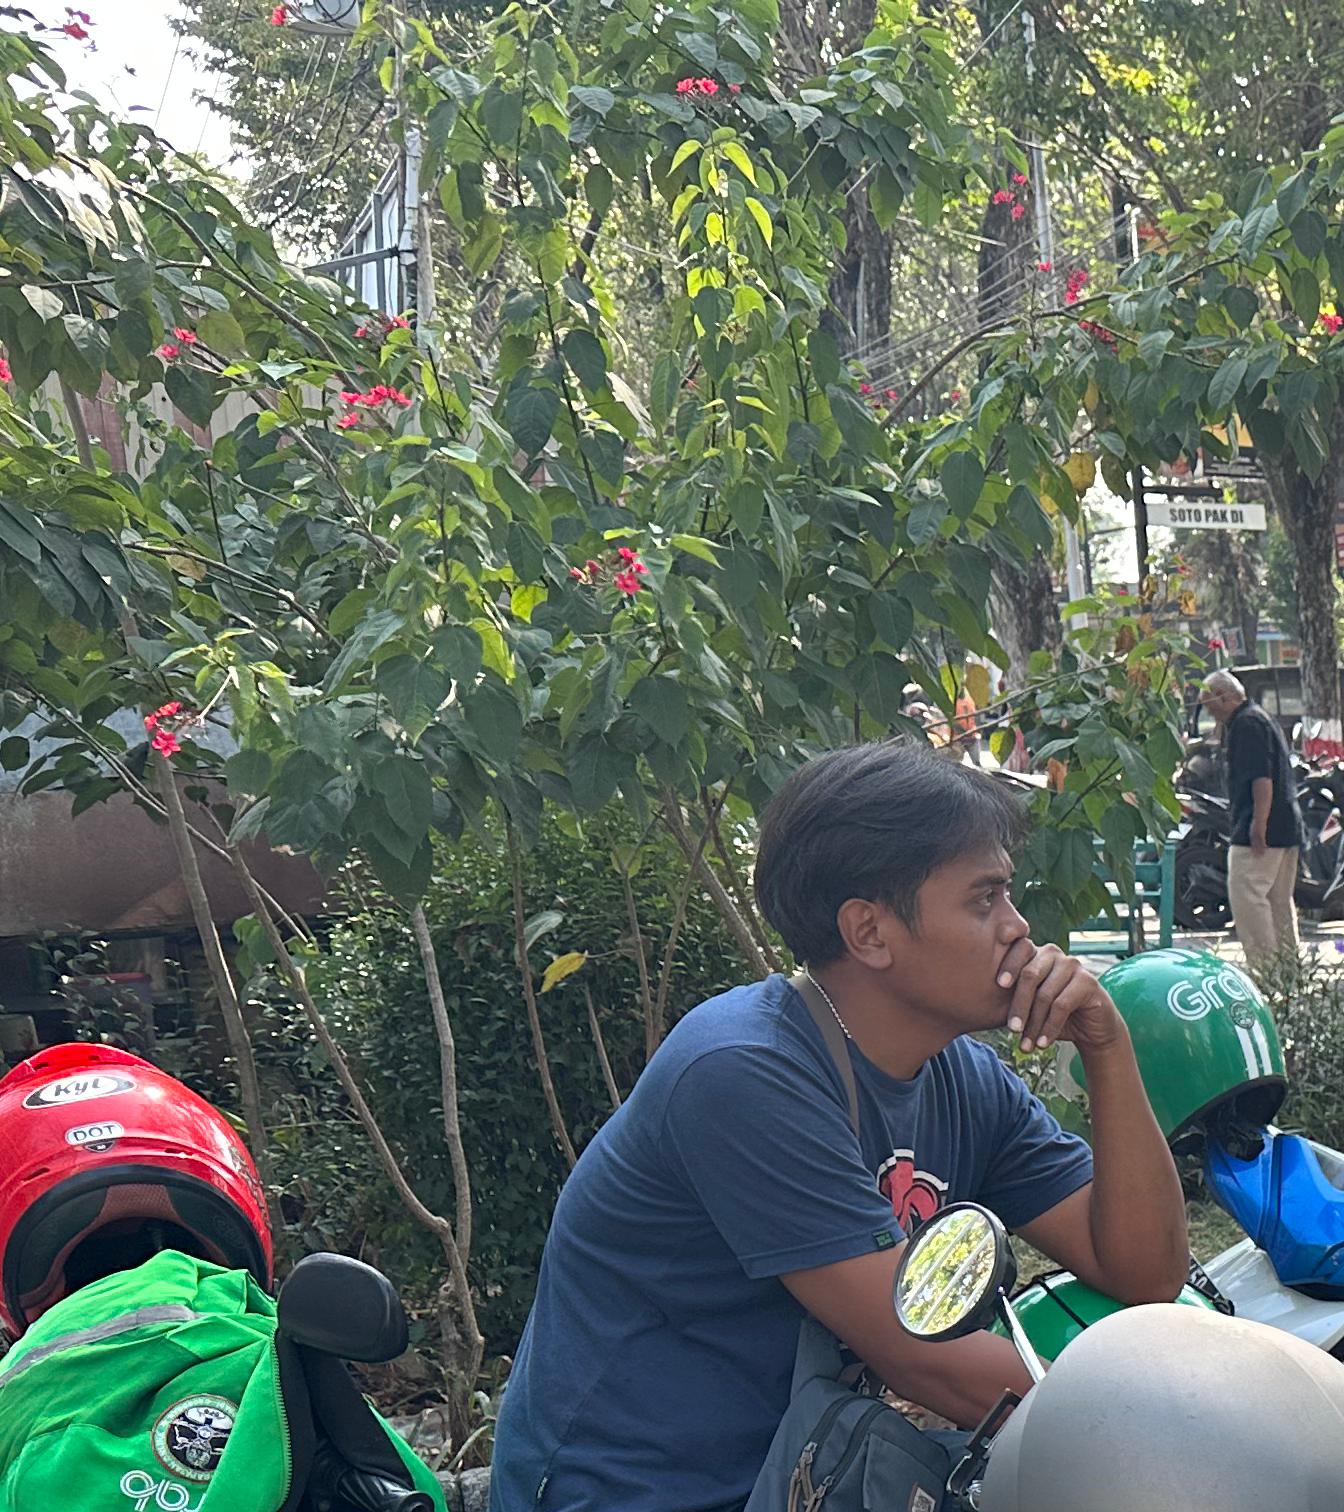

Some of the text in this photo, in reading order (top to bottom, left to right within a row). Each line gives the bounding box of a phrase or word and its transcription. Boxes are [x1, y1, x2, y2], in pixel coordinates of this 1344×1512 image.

[1169, 504, 1244, 524] SOTO PAK DI
[73, 1124, 116, 1142] DOT
